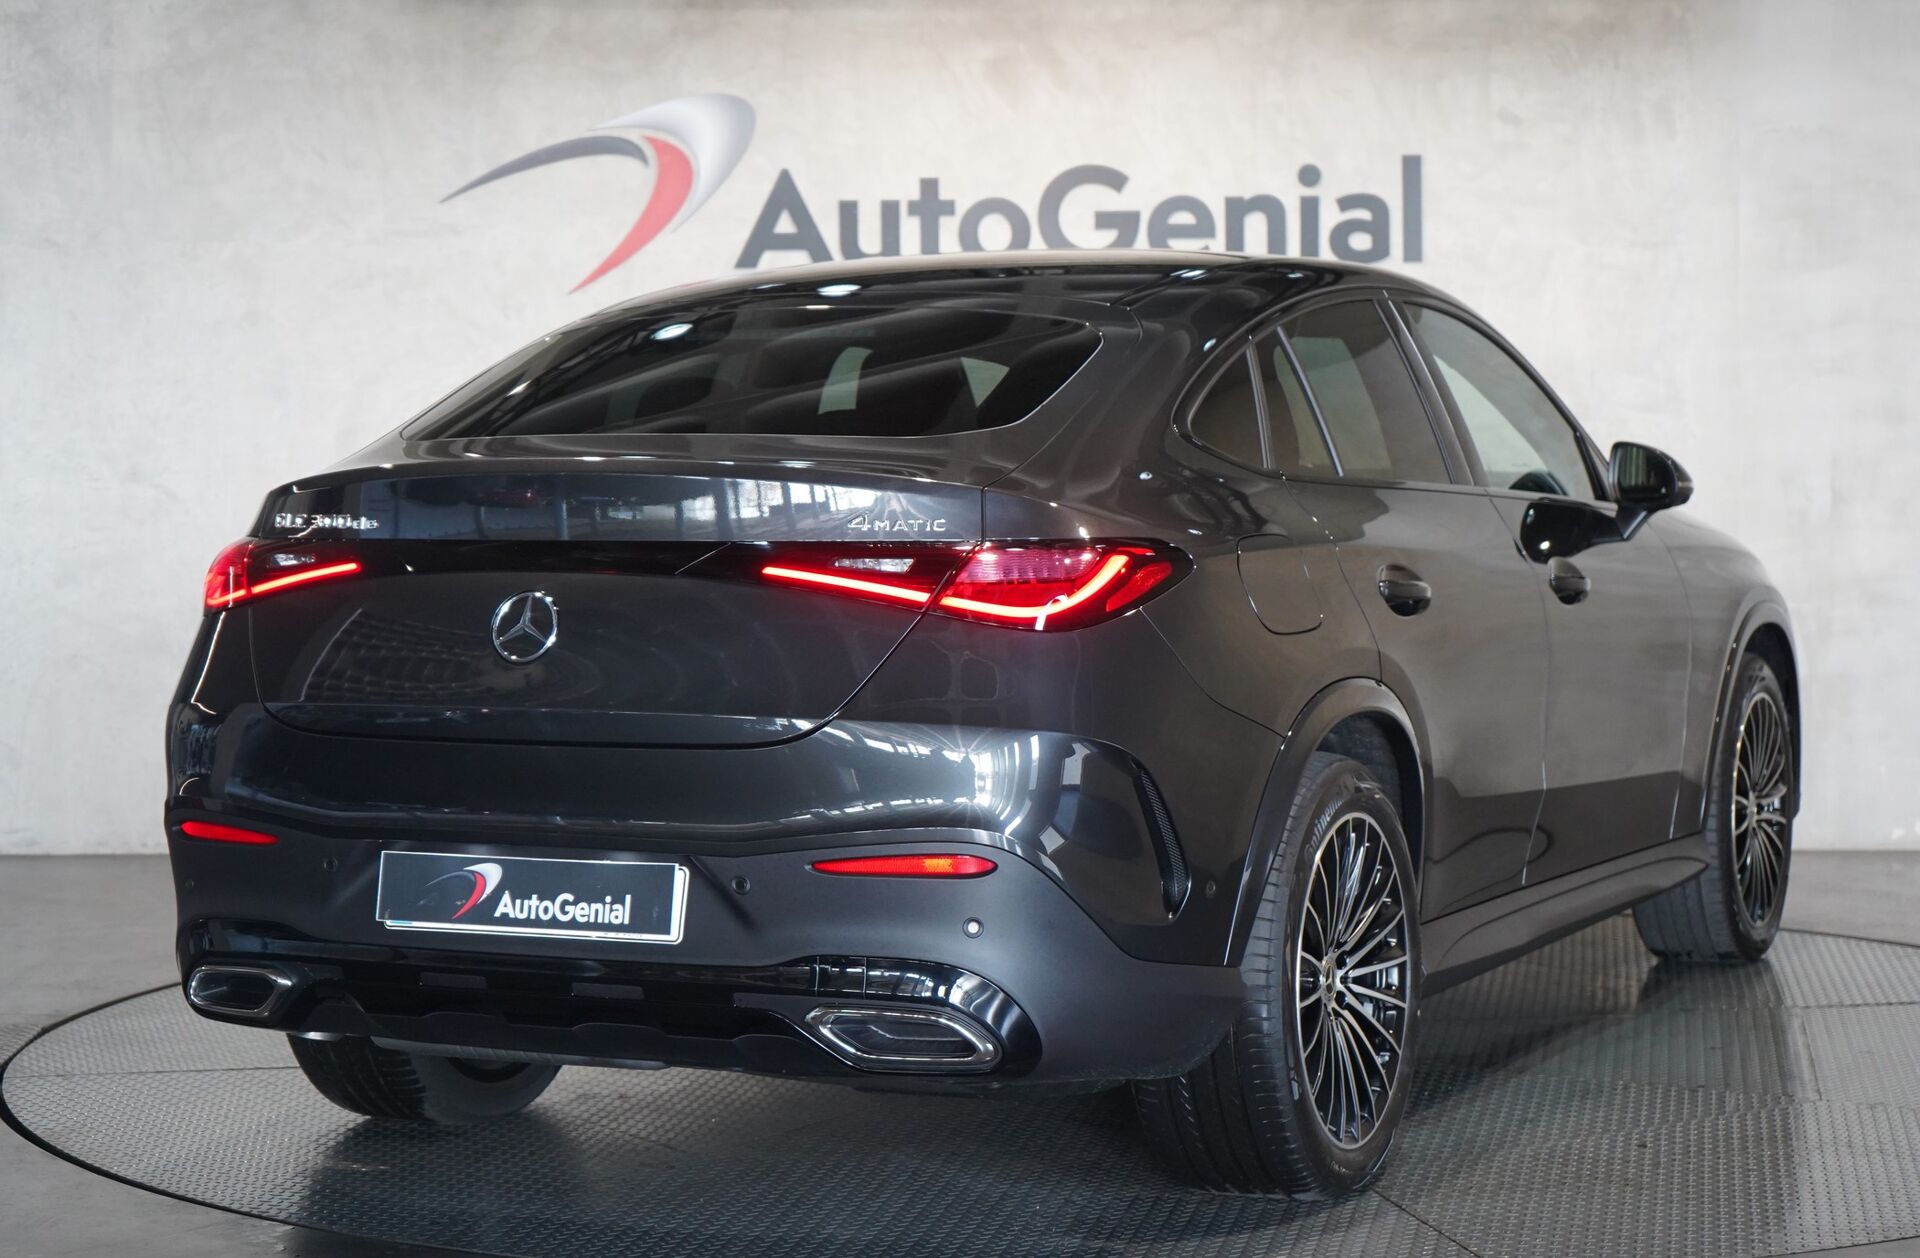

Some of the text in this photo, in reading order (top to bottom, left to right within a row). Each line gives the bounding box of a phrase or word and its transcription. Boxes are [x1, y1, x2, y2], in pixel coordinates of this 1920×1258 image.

[735, 155, 1423, 268] AutoGenial
[847, 514, 946, 532] 4MATIC
[493, 890, 632, 925] AutoGenial
